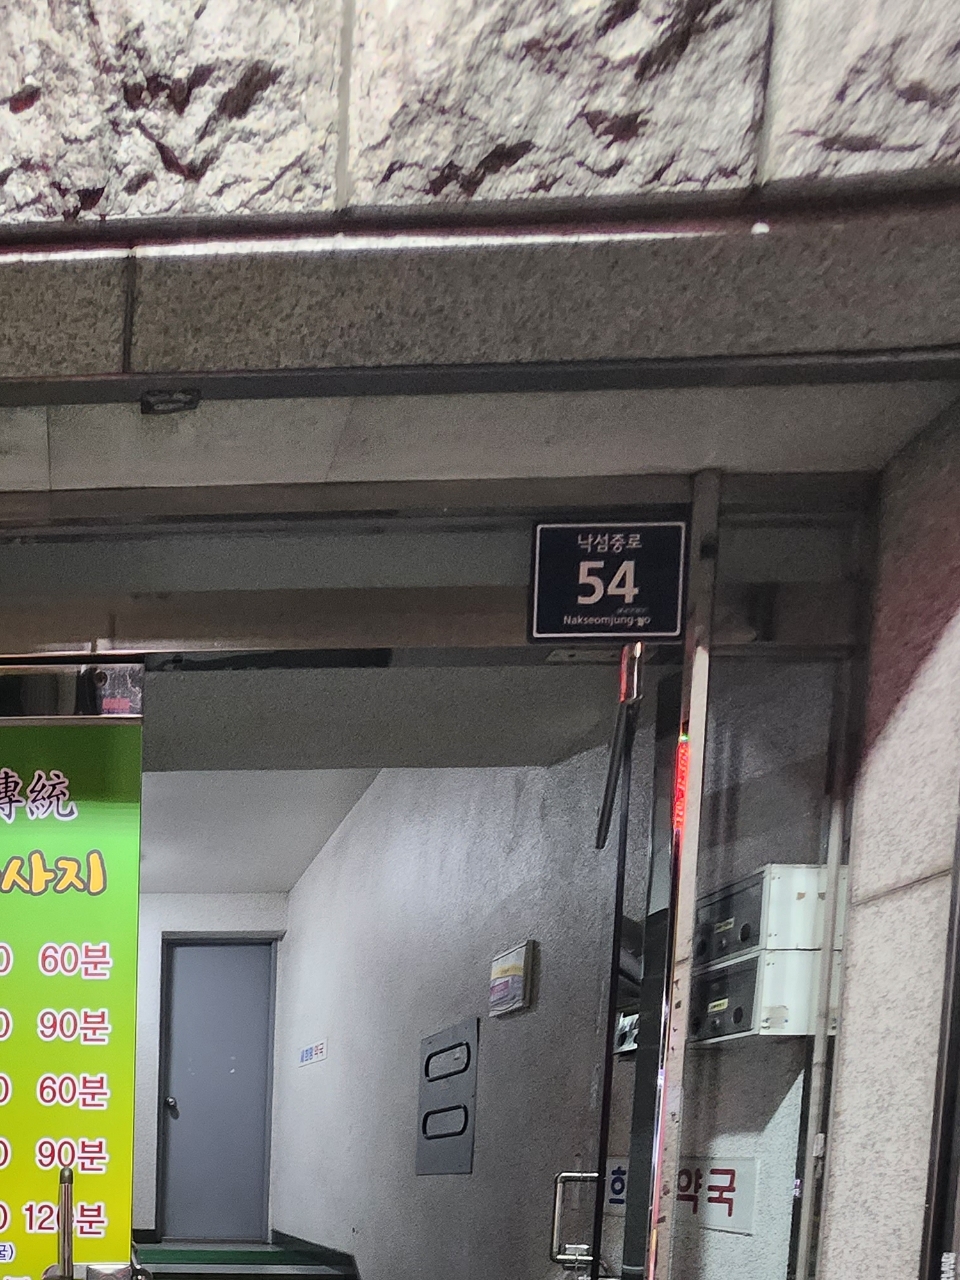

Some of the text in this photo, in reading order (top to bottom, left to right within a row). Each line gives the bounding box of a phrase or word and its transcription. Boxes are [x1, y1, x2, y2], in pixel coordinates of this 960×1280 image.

[576, 533, 643, 553] 낙섬중로
[576, 560, 640, 606] 54
[39, 944, 112, 978] 60분
[38, 1011, 111, 1045] 90분
[37, 1074, 110, 1109] 60분
[37, 1139, 107, 1172] 90분
[24, 1203, 106, 1236] 12분
